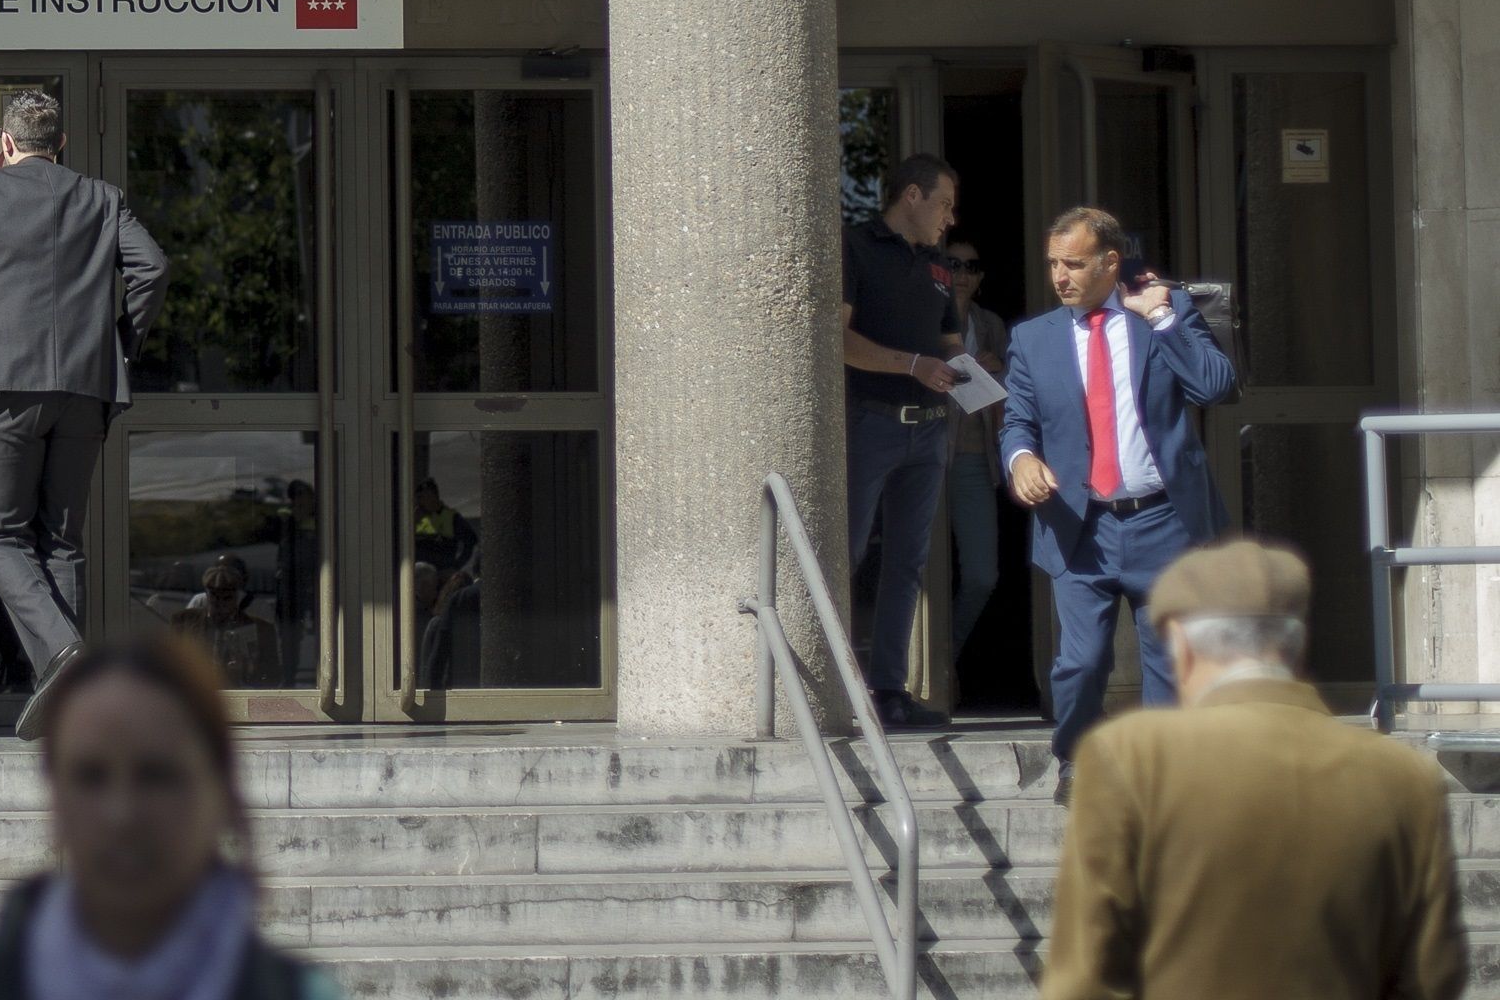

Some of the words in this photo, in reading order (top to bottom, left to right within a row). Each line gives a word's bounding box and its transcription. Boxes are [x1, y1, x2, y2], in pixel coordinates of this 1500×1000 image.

[433, 225, 491, 239] ENTRADA
[495, 225, 550, 239] PUBLICO
[451, 246, 488, 254] HORARIO
[490, 246, 532, 254] APERTURA
[447, 257, 481, 266] LUNES
[483, 257, 491, 266] A
[493, 257, 536, 266] VIERNES
[449, 267, 463, 276] DE
[465, 267, 486, 276] 8:30
[468, 278, 517, 287] SABADOS
[433, 302, 452, 310] PARA
[454, 302, 476, 310] ABRIR
[477, 302, 498, 310] TIRAR
[499, 302, 521, 310] HACIA
[523, 302, 551, 310] AFUERA
